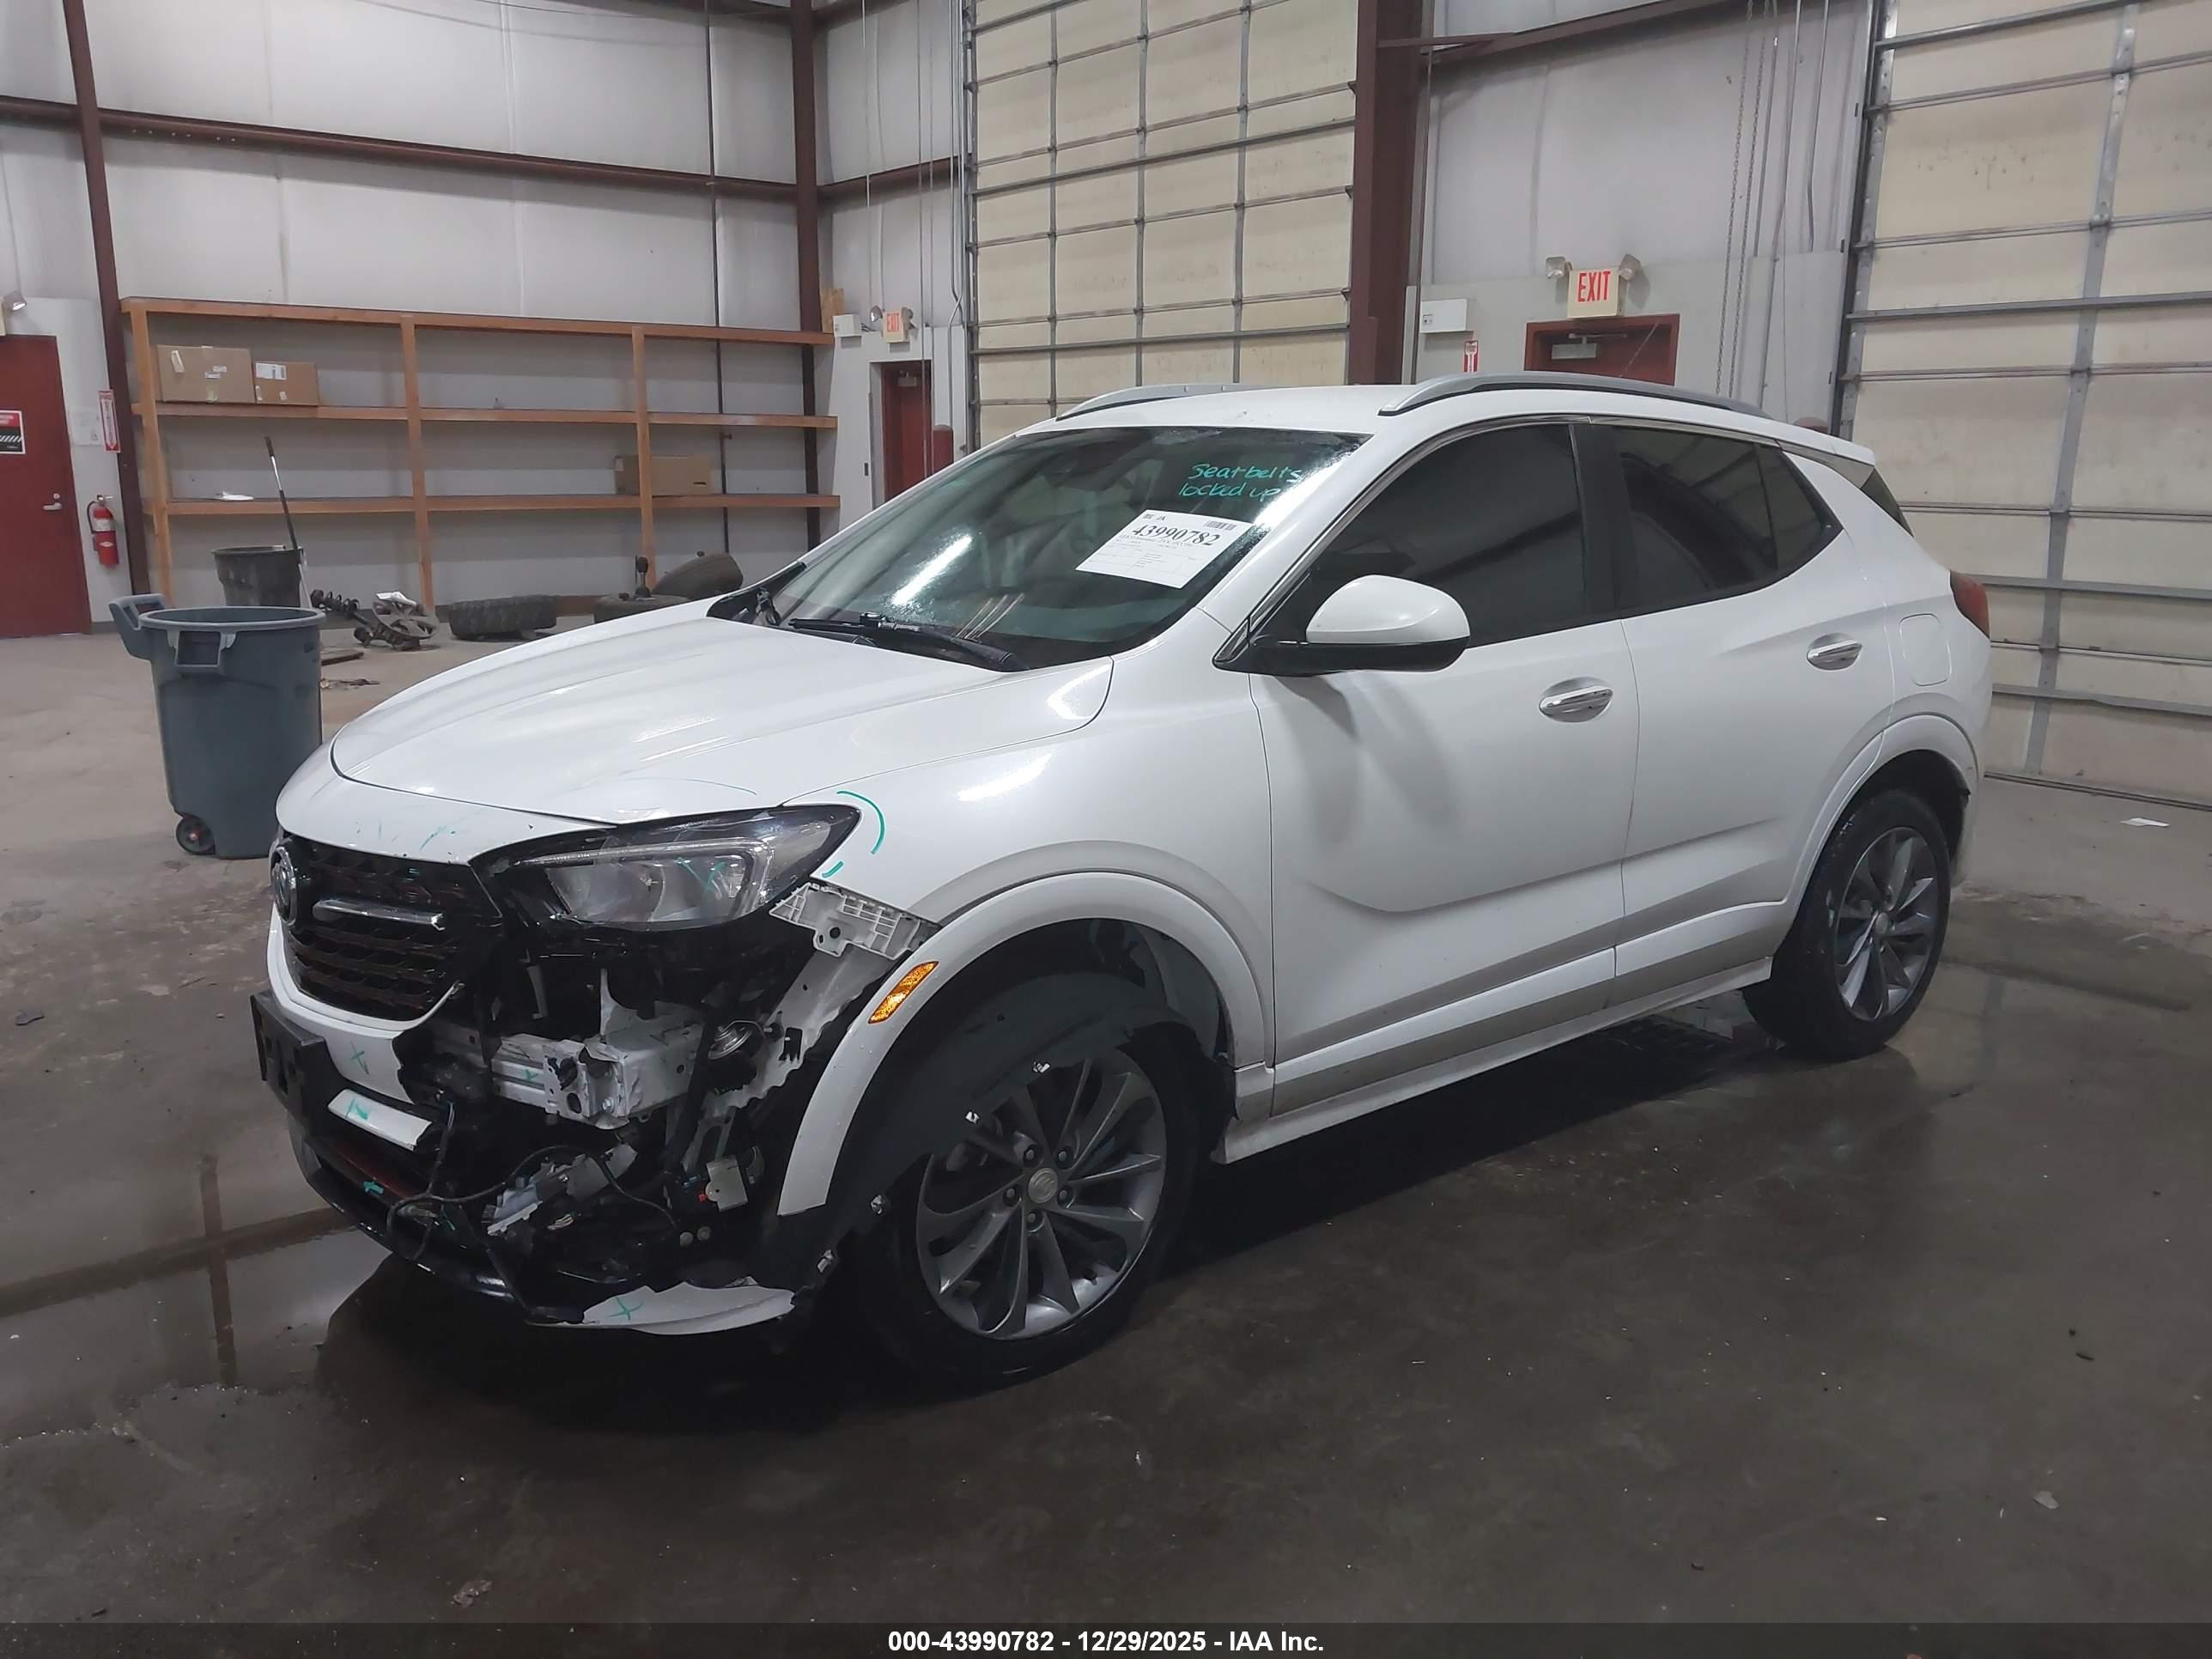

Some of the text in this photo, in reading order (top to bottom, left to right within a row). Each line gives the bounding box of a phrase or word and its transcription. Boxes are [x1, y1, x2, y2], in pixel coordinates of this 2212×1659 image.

[1577, 270, 1612, 302] EXIT
[1249, 487, 1281, 501] up
[1132, 524, 1220, 545] 43990782
